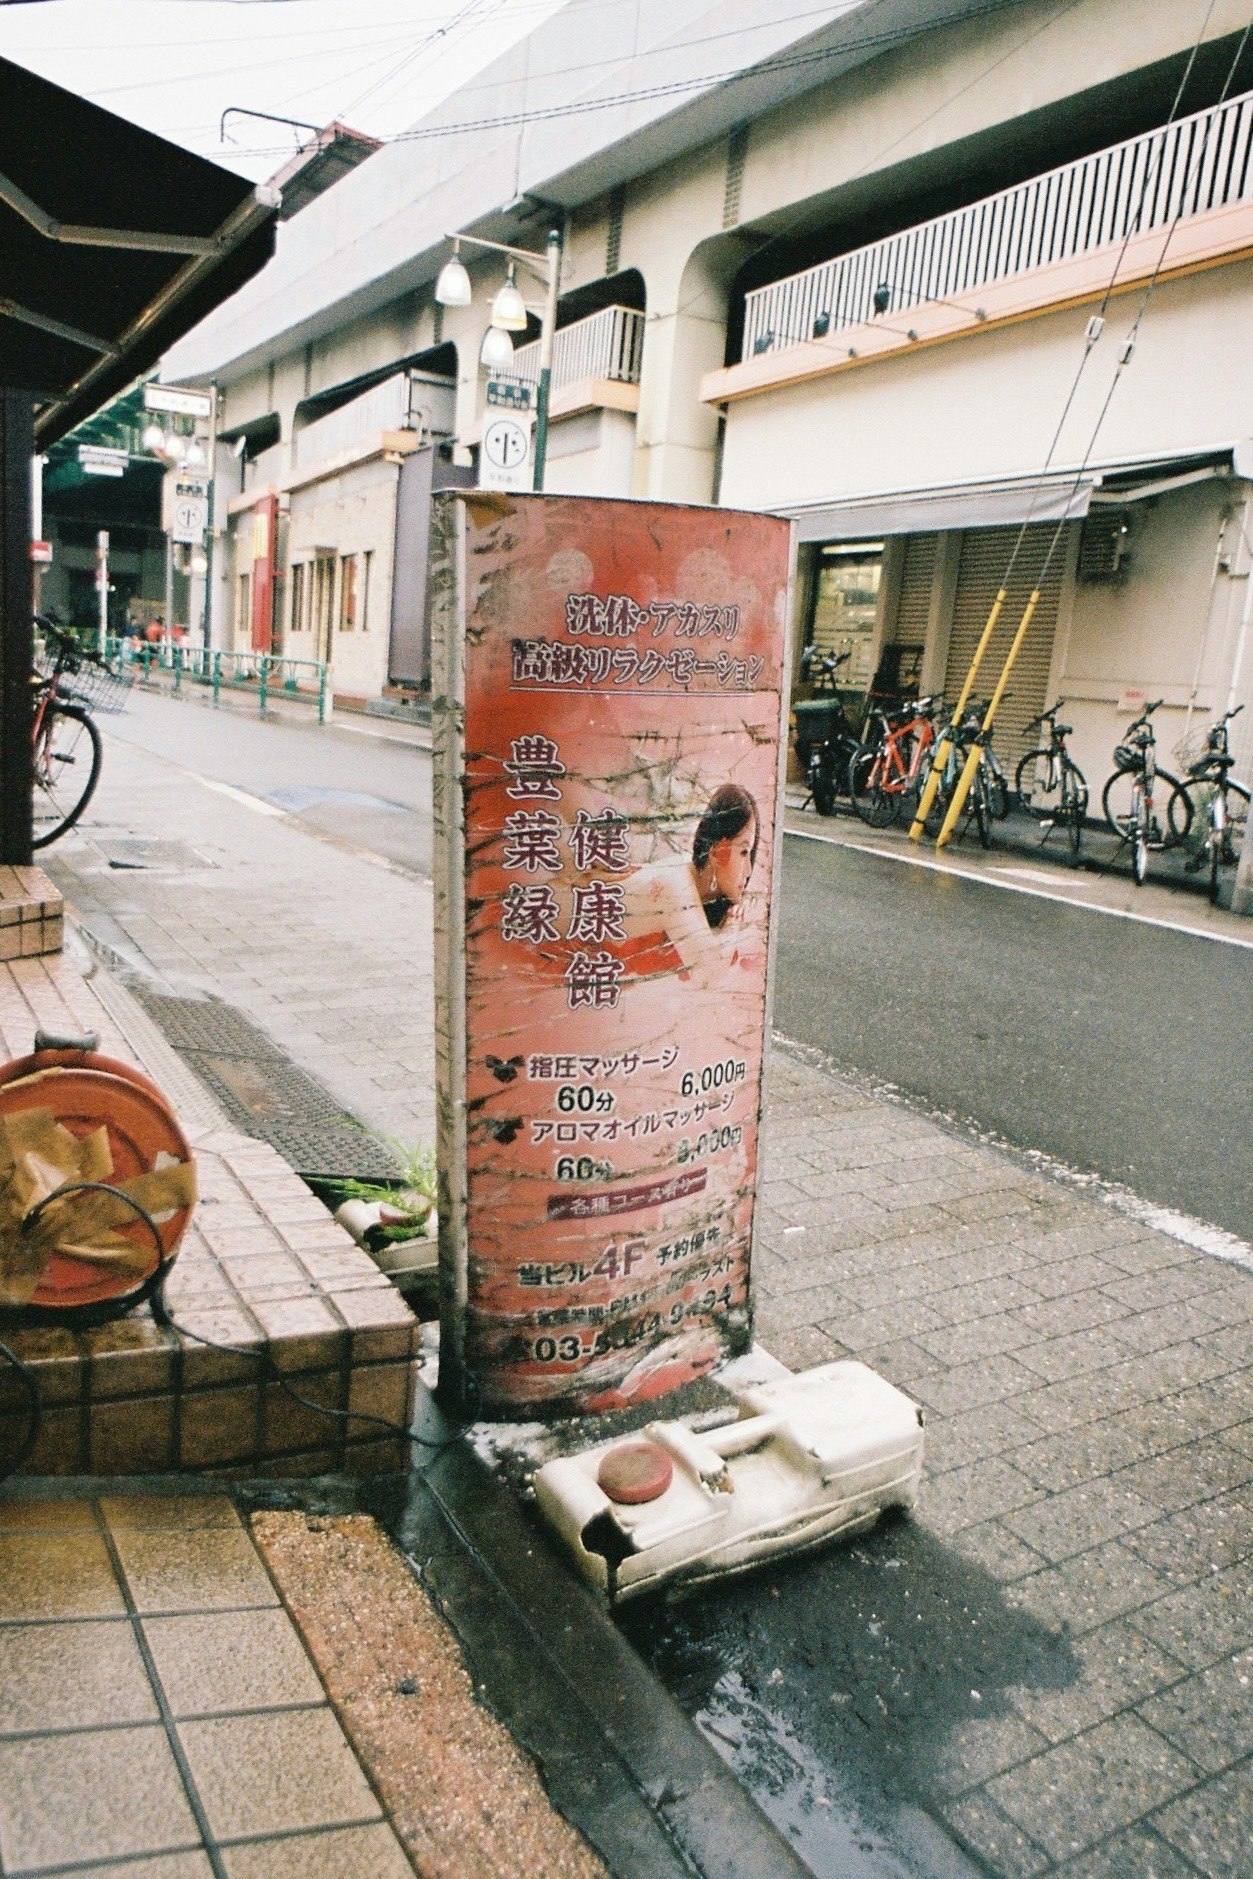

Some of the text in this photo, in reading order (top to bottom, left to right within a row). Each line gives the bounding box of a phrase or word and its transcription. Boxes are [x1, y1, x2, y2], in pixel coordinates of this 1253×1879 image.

[512, 640, 766, 687] 高級リラクゼーション
[565, 808, 630, 1010] 健康館
[528, 1046, 681, 1080] 指圧マッサージ
[556, 1058, 746, 1113] 60分 6,000円
[531, 1091, 736, 1144] アロマオイルマッサージ
